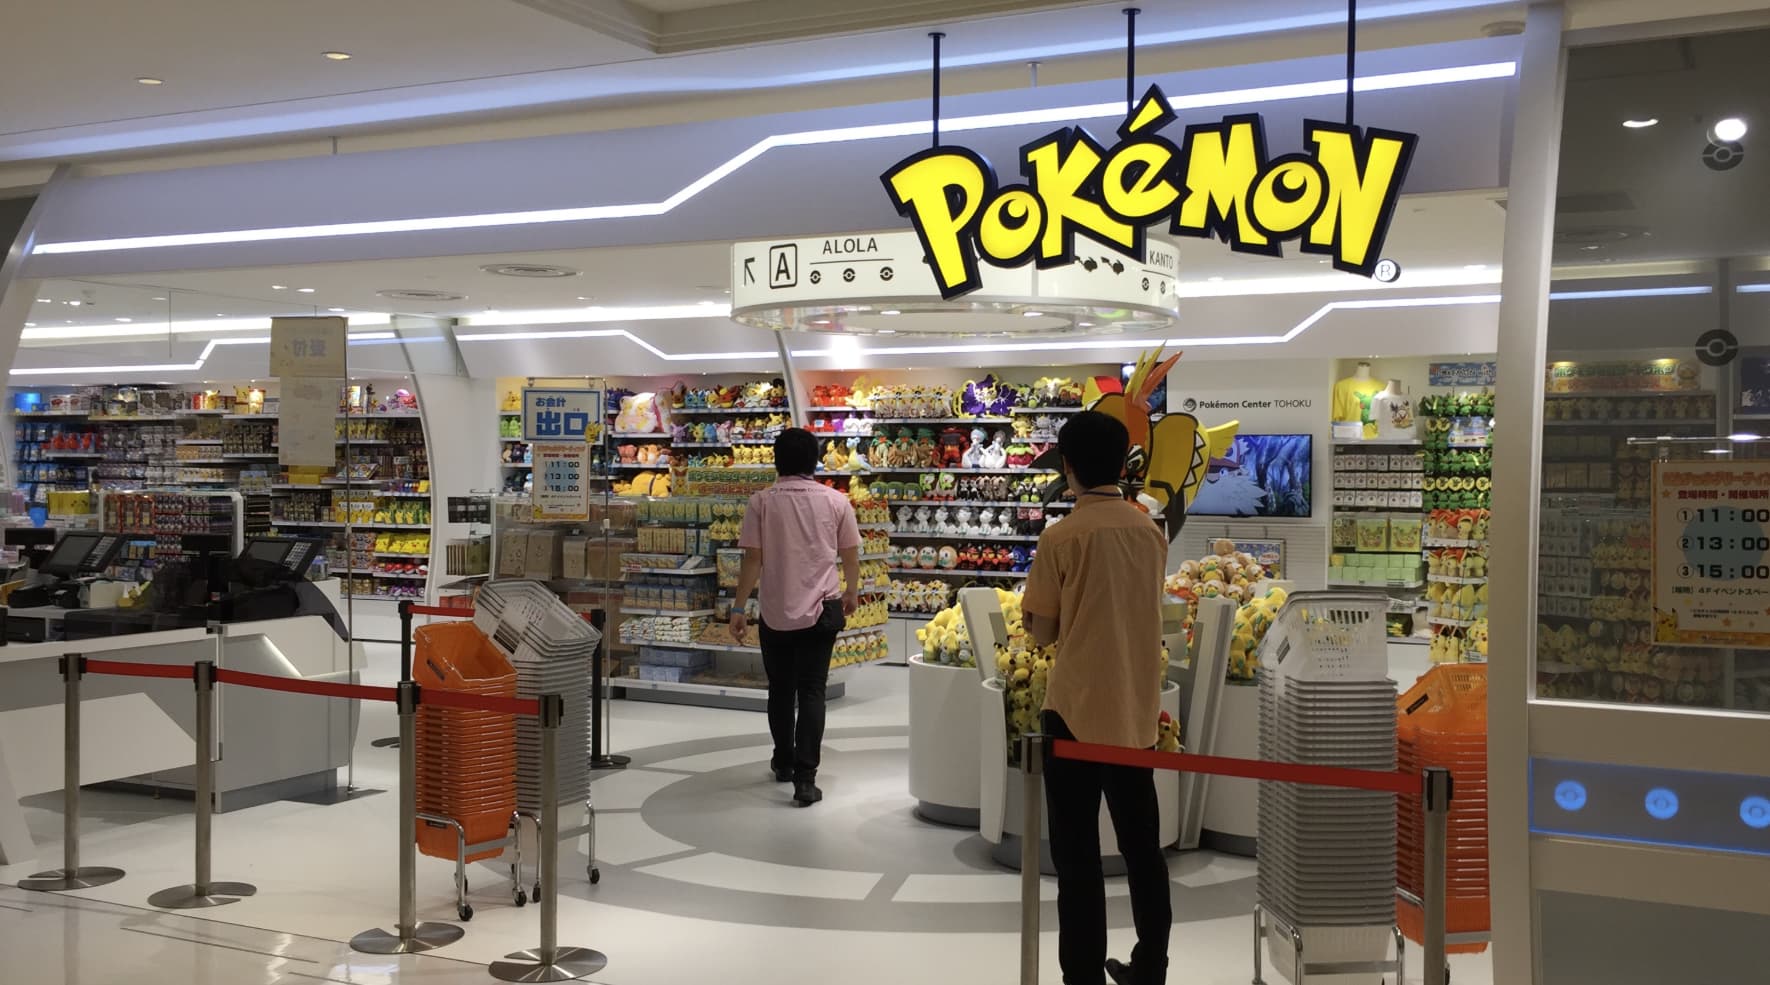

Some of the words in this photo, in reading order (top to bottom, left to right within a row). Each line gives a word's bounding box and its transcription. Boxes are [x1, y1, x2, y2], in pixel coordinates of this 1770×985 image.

[822, 238, 878, 254] ALOLA
[775, 252, 791, 281] A
[1149, 249, 1174, 270] KANTO
[535, 396, 567, 407] お会計
[1199, 400, 1239, 409] Pokémon
[1242, 400, 1271, 408] Center
[1274, 399, 1312, 408] TOHOKU
[536, 410, 589, 436] 出口
